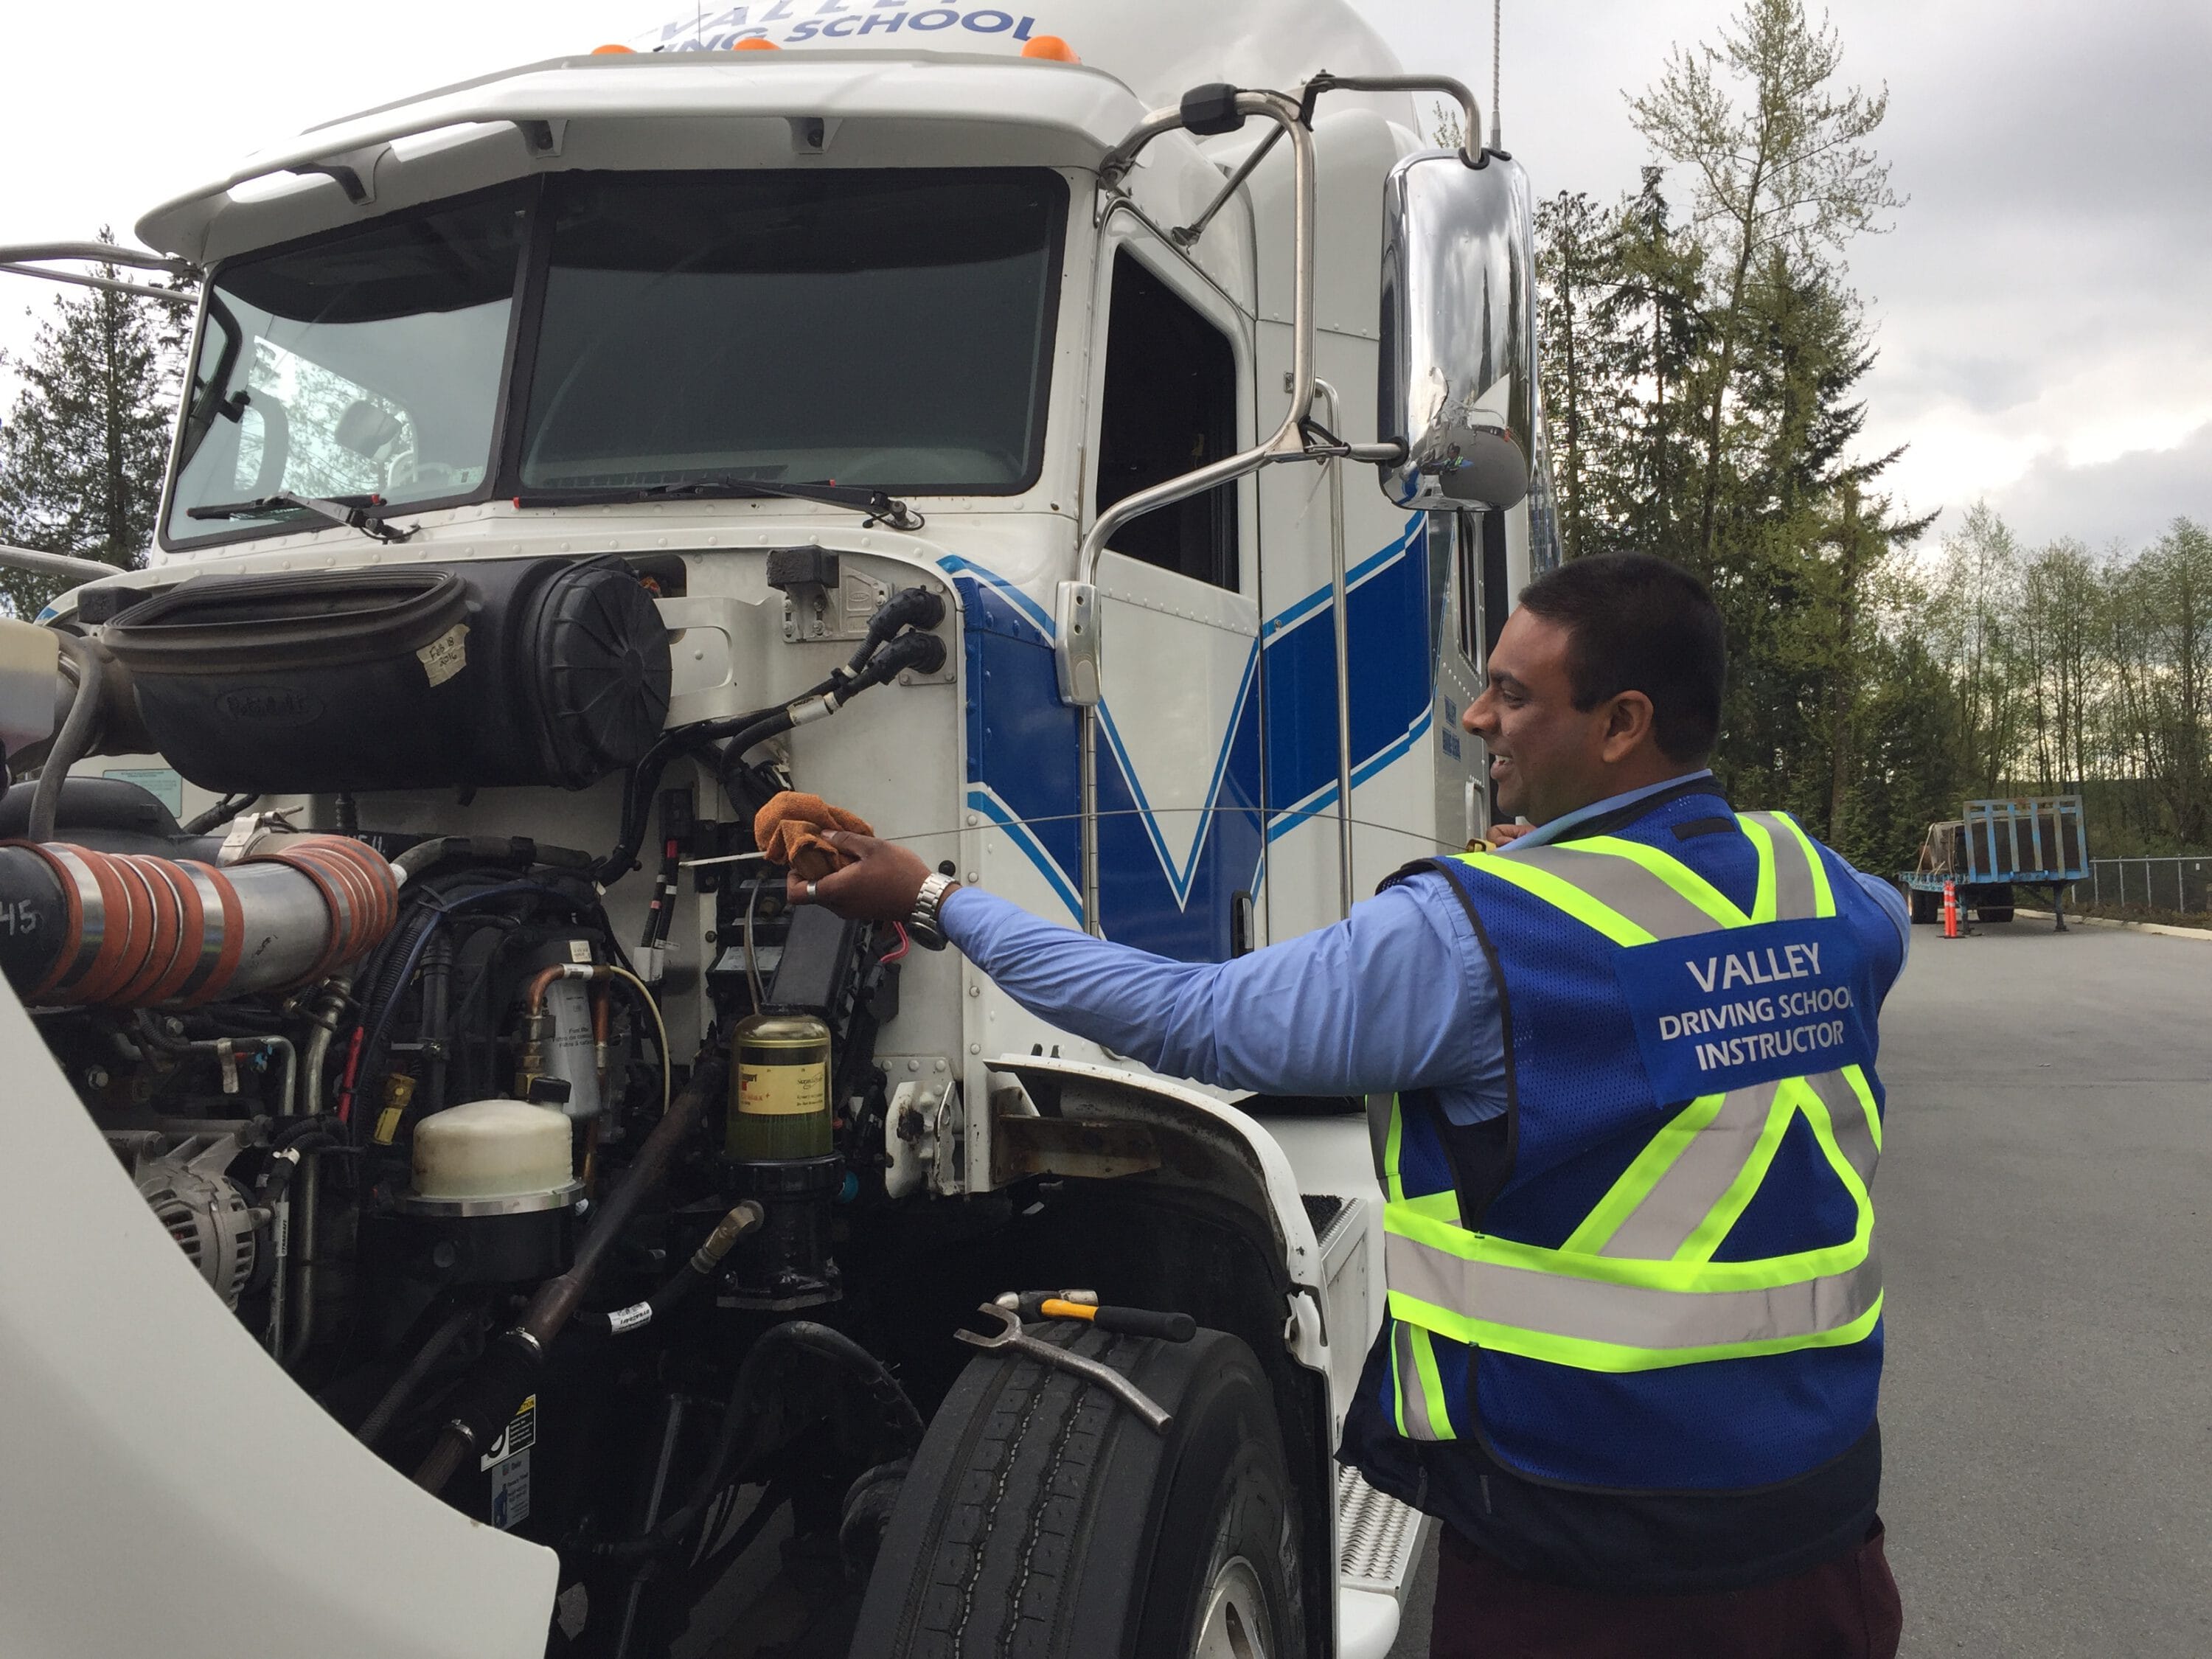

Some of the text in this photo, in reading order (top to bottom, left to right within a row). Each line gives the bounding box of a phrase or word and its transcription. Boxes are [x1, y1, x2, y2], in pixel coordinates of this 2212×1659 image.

[661, 0, 956, 41] VALL
[783, 9, 1035, 43] SCHOOL
[1686, 942, 1821, 992] VALLEY
[1659, 998, 1775, 1040] DRIVING
[1695, 1020, 1844, 1071] INSTRUCTOR
